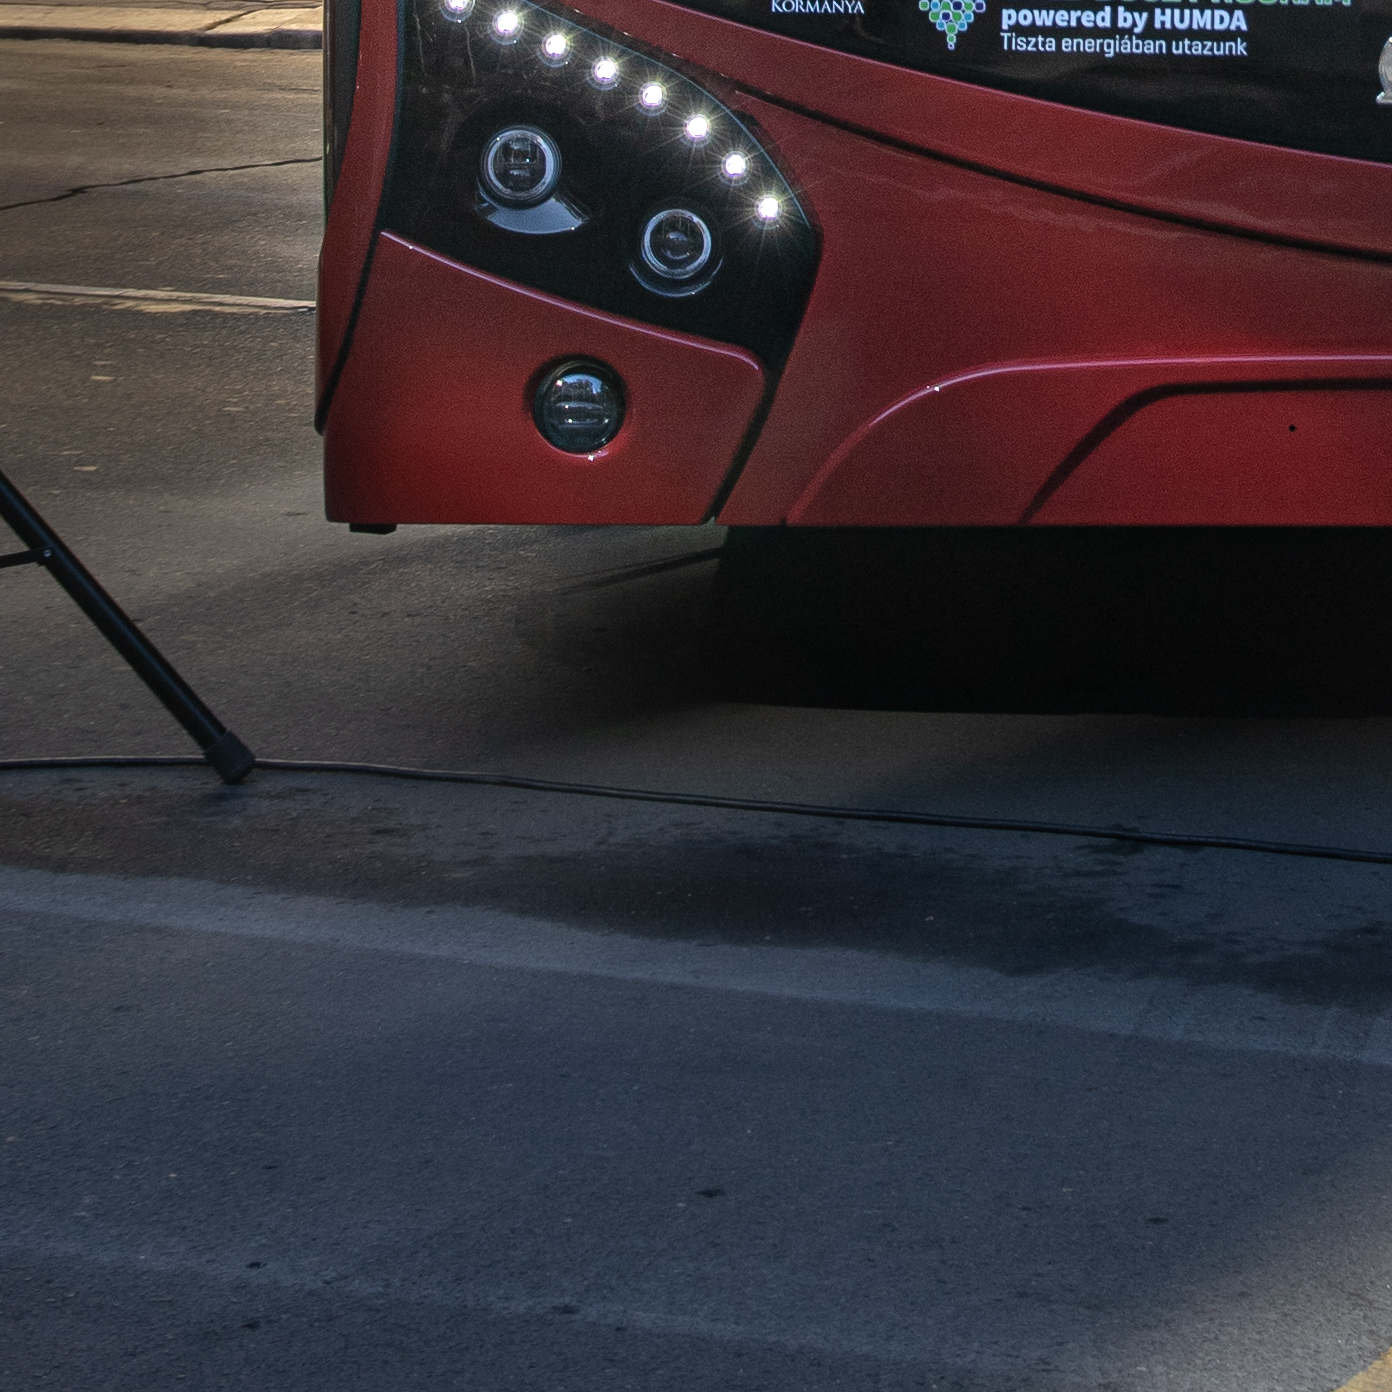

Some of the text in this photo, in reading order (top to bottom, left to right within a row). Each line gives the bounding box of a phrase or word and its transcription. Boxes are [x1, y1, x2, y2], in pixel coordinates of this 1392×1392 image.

[1001, 6, 1248, 33] powered by HUMDA
[1000, 32, 1248, 58] Tiszta energiában utazunk
